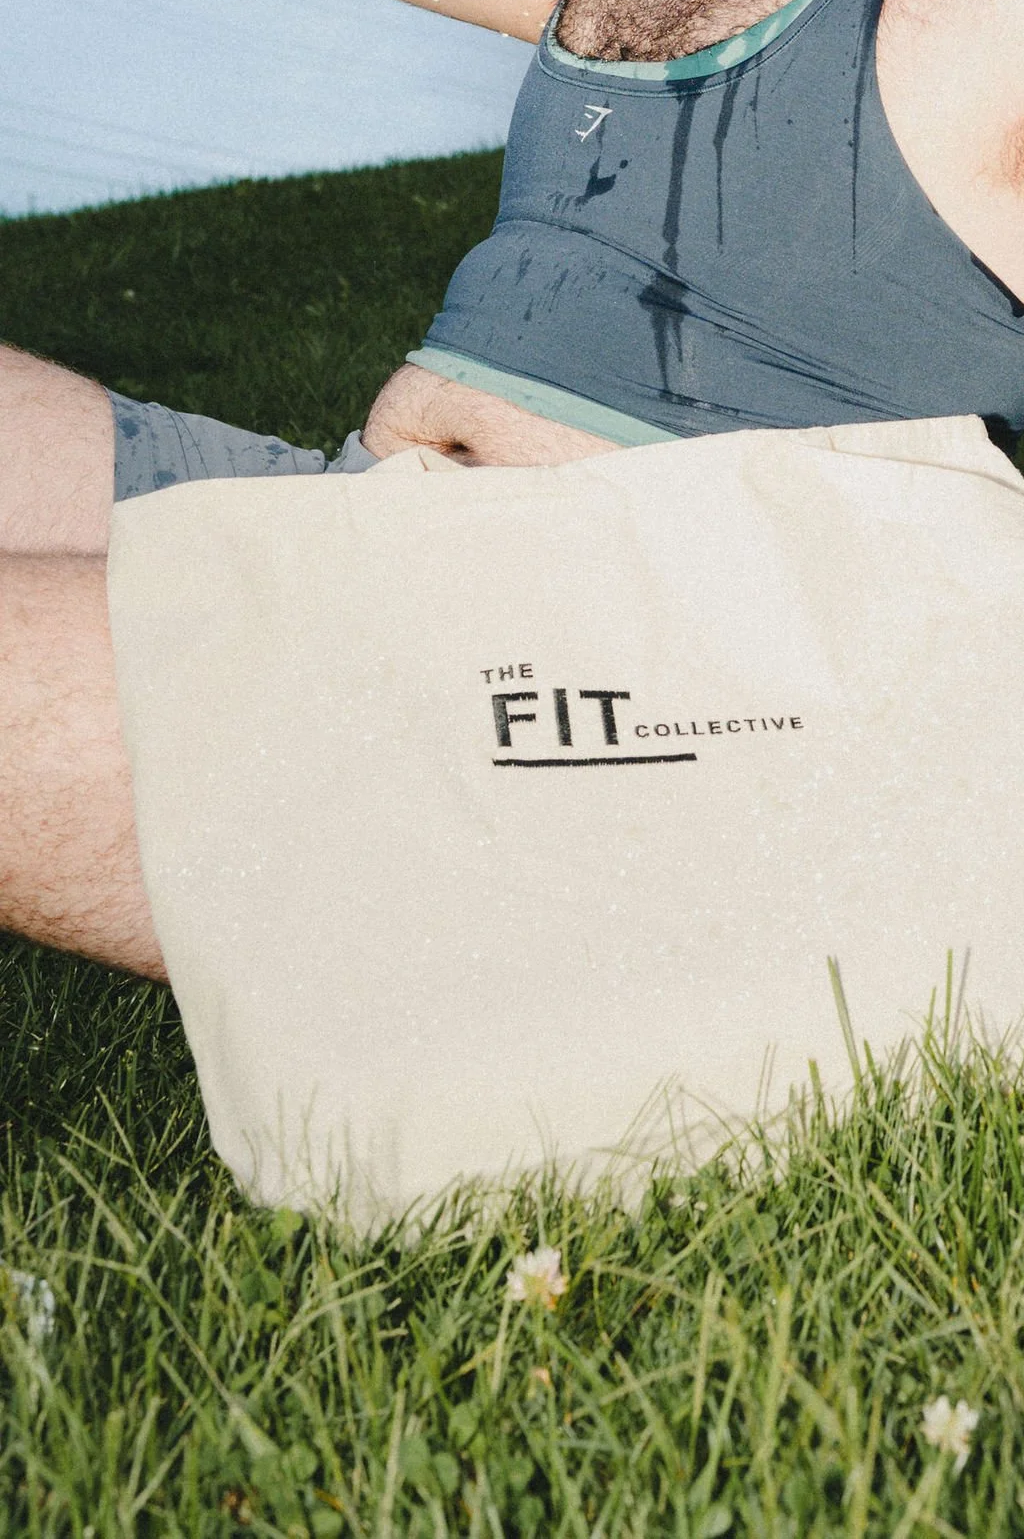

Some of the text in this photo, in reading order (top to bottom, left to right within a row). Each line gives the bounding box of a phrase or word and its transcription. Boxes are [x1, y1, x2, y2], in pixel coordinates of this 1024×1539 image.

[480, 663, 534, 684] THE
[492, 688, 805, 747] FIT COLLECTIVE
